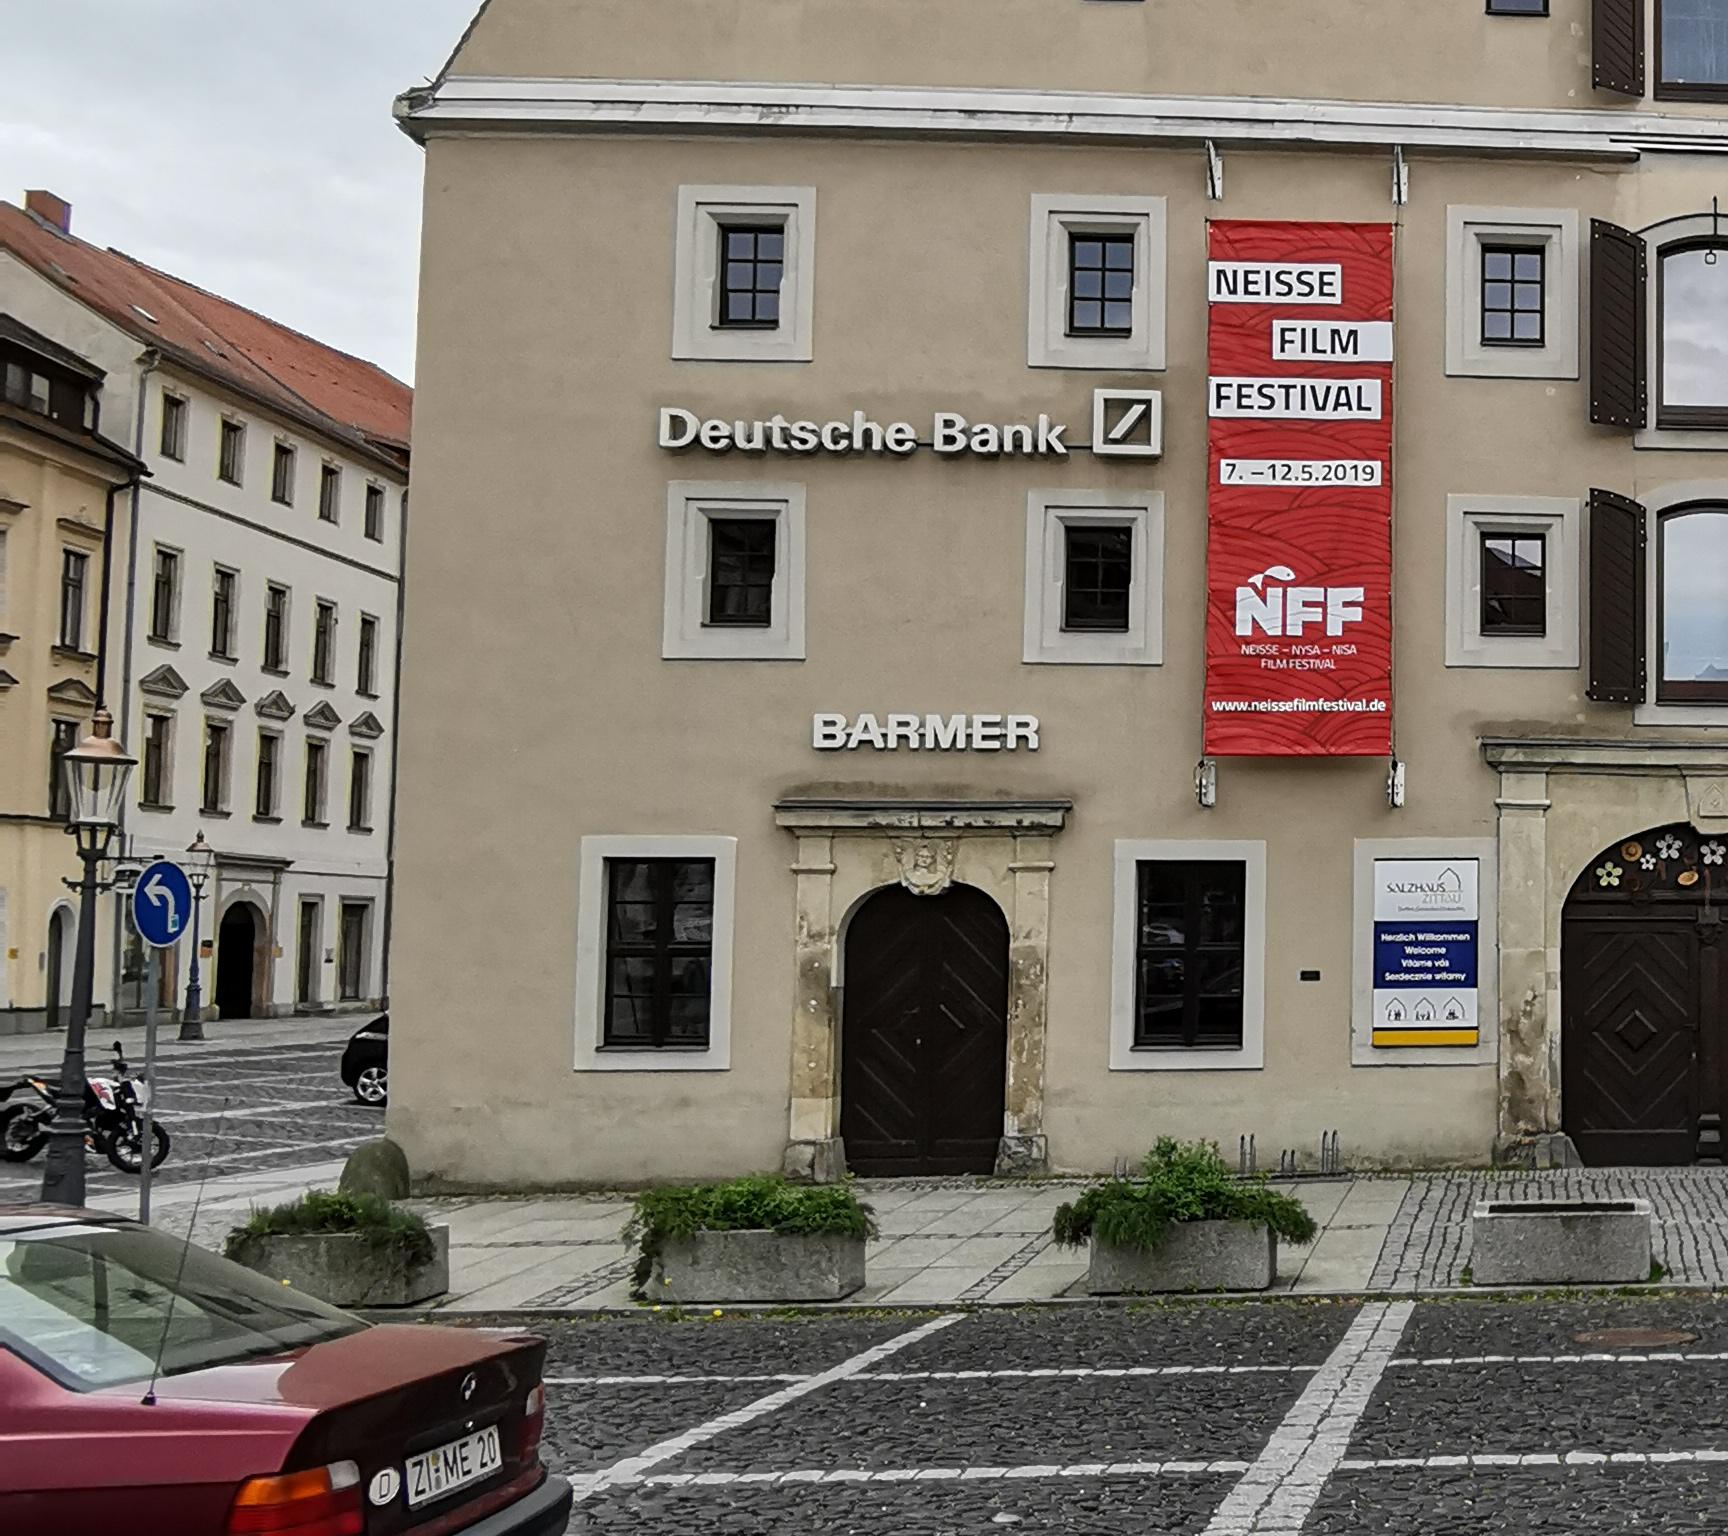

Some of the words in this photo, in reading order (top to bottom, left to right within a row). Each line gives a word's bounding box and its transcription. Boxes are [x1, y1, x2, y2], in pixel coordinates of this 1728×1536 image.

[1215, 268, 1337, 298] NEISSE
[1279, 326, 1359, 356] FILM
[1215, 383, 1372, 412] FESTIVAL
[658, 407, 918, 454] Deutsche
[934, 412, 1070, 454] Bank
[1235, 587, 1365, 636] NFF
[1241, 644, 1279, 655] NEISSE
[1291, 645, 1321, 655] NYSA
[1332, 645, 1357, 655] NISA
[1261, 659, 1287, 669] FILM
[1290, 659, 1336, 670] FESTIVAL
[1212, 698, 1386, 712] www.neissefilmfestival.de
[813, 713, 1040, 749] BARMER
[1387, 883, 1446, 893] SALZHAUS
[1422, 894, 1461, 904] ZITTAU
[1381, 933, 1416, 942] Herzlich
[1417, 933, 1471, 942] Willkommen
[1404, 946, 1447, 955] Welcome
[477, 1430, 498, 1469] 20
[379, 1473, 390, 1499] D
